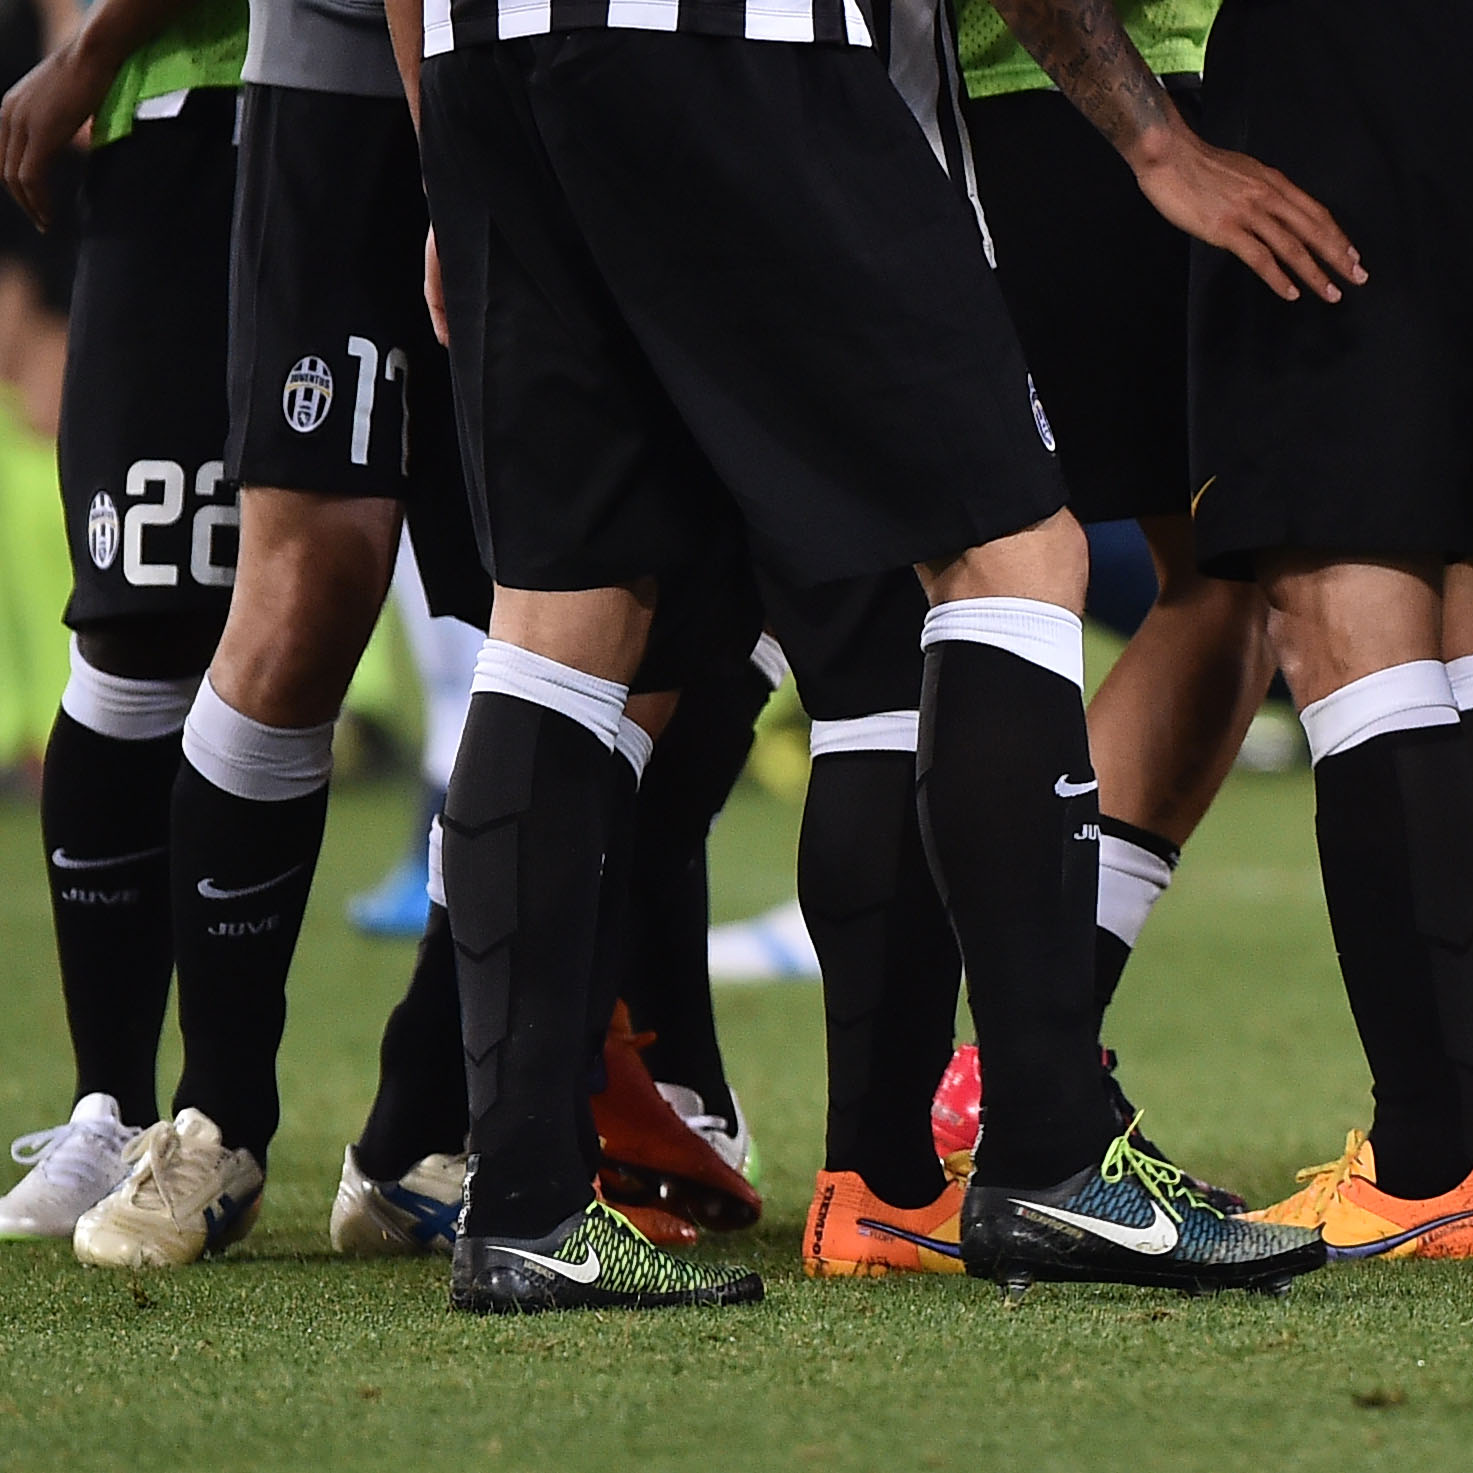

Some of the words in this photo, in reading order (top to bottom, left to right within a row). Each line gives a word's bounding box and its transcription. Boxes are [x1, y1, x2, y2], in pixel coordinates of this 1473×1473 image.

[290, 372, 331, 389] JUVENTUS
[123, 459, 241, 587] 22
[812, 1184, 836, 1256] TIEMPO
